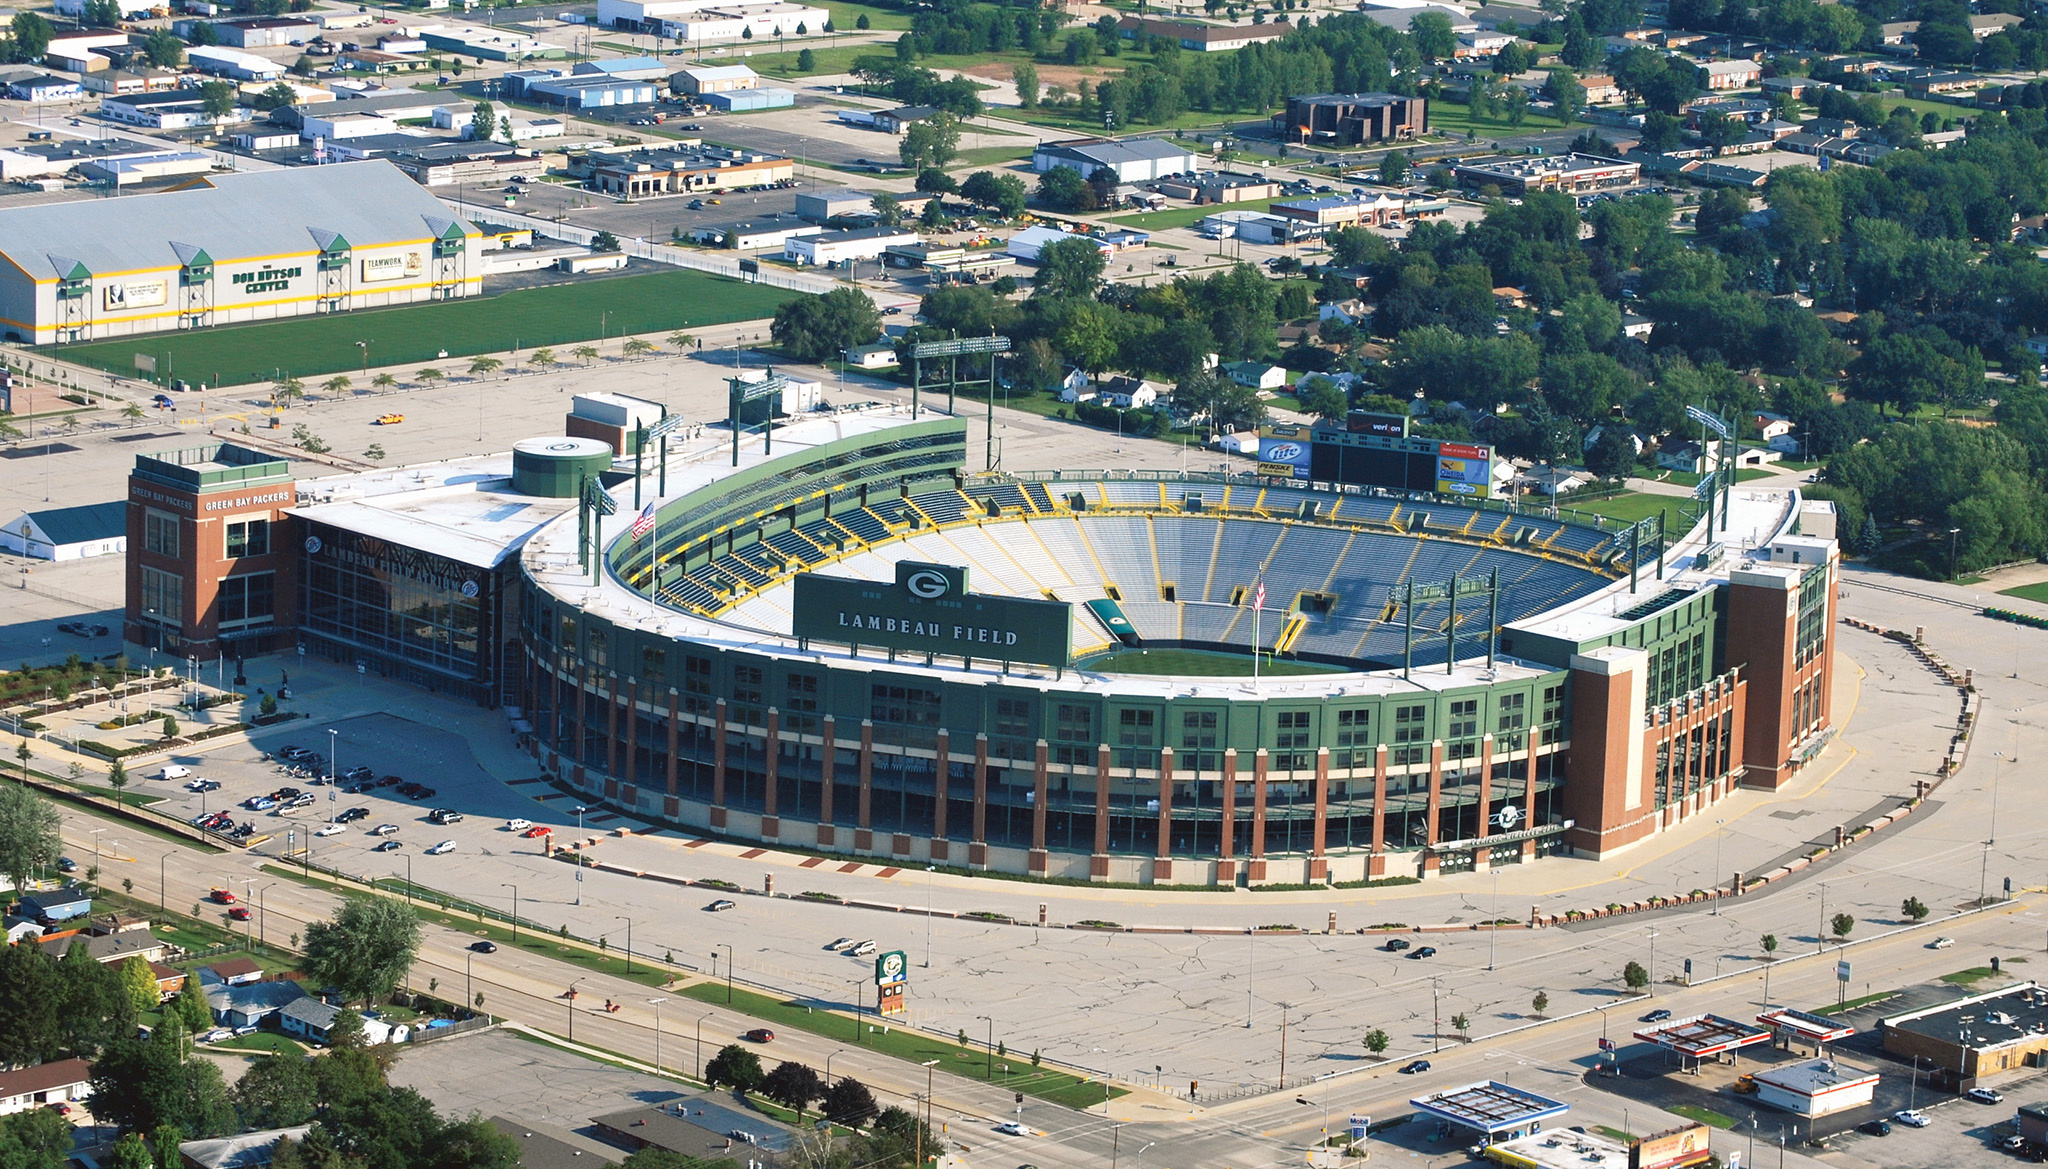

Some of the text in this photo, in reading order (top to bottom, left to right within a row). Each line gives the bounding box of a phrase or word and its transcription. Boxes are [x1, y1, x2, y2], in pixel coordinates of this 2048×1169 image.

[368, 257, 402, 267] TEAMWORK
[232, 266, 302, 284] DON HUTSON
[245, 280, 289, 294] CENTER
[1372, 423, 1401, 433] verizon
[1273, 448, 1298, 460] Lite
[1260, 463, 1291, 471] PENSKE
[1440, 469, 1465, 477] ONEIDA
[132, 486, 193, 510] GREEN BAY PACKERS
[205, 491, 289, 511] GREEN BAY PACKERS
[324, 544, 461, 593] LAMBEAU FIELD ATRIUM
[839, 612, 1017, 646] LAMBEAU FIELD
